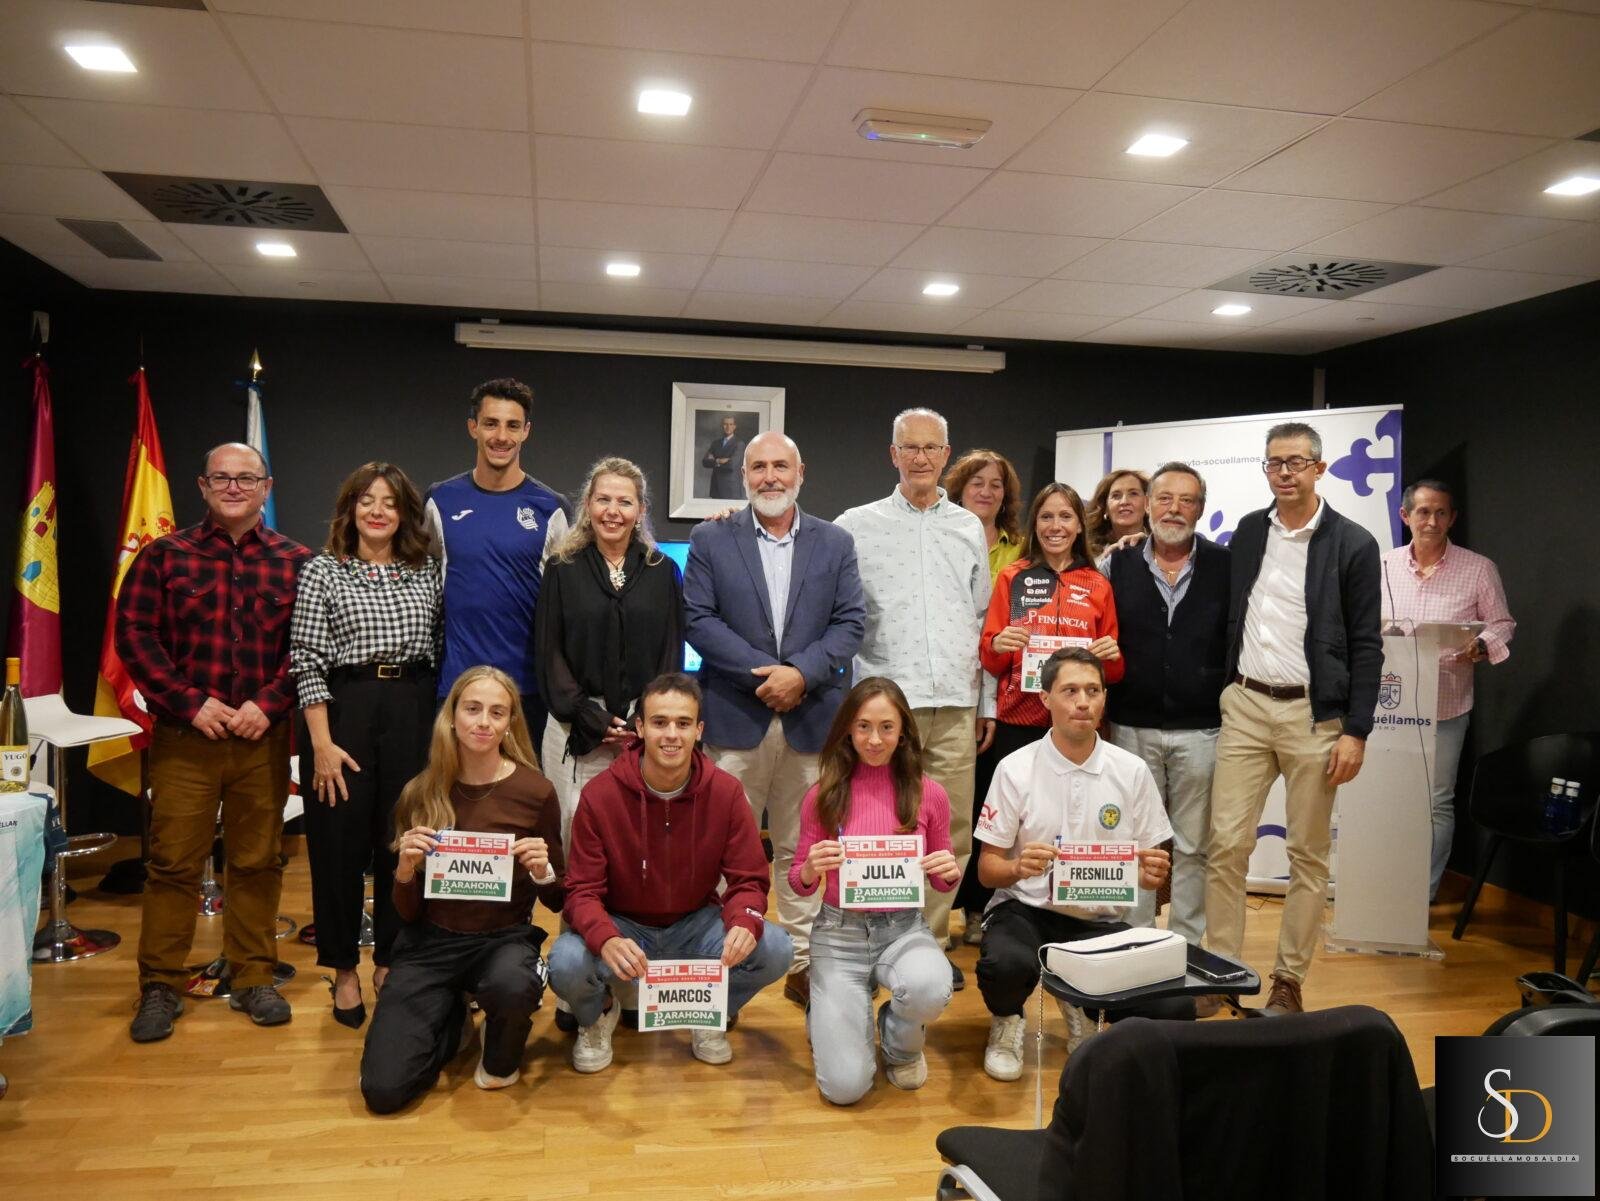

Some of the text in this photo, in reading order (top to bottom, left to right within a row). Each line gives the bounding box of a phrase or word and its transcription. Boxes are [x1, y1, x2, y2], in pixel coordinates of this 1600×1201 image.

[1038, 615, 1088, 630] FINANCIAL
[1372, 714, 1431, 726] uéllamos
[846, 840, 916, 852] SOLISS
[1060, 844, 1132, 854] SOLISS
[448, 860, 494, 875] ANNA
[862, 864, 906, 880] JULIA
[1070, 868, 1124, 880] FRESNILLO
[647, 965, 720, 976] SOLISS
[658, 990, 712, 1003] MARCOS
